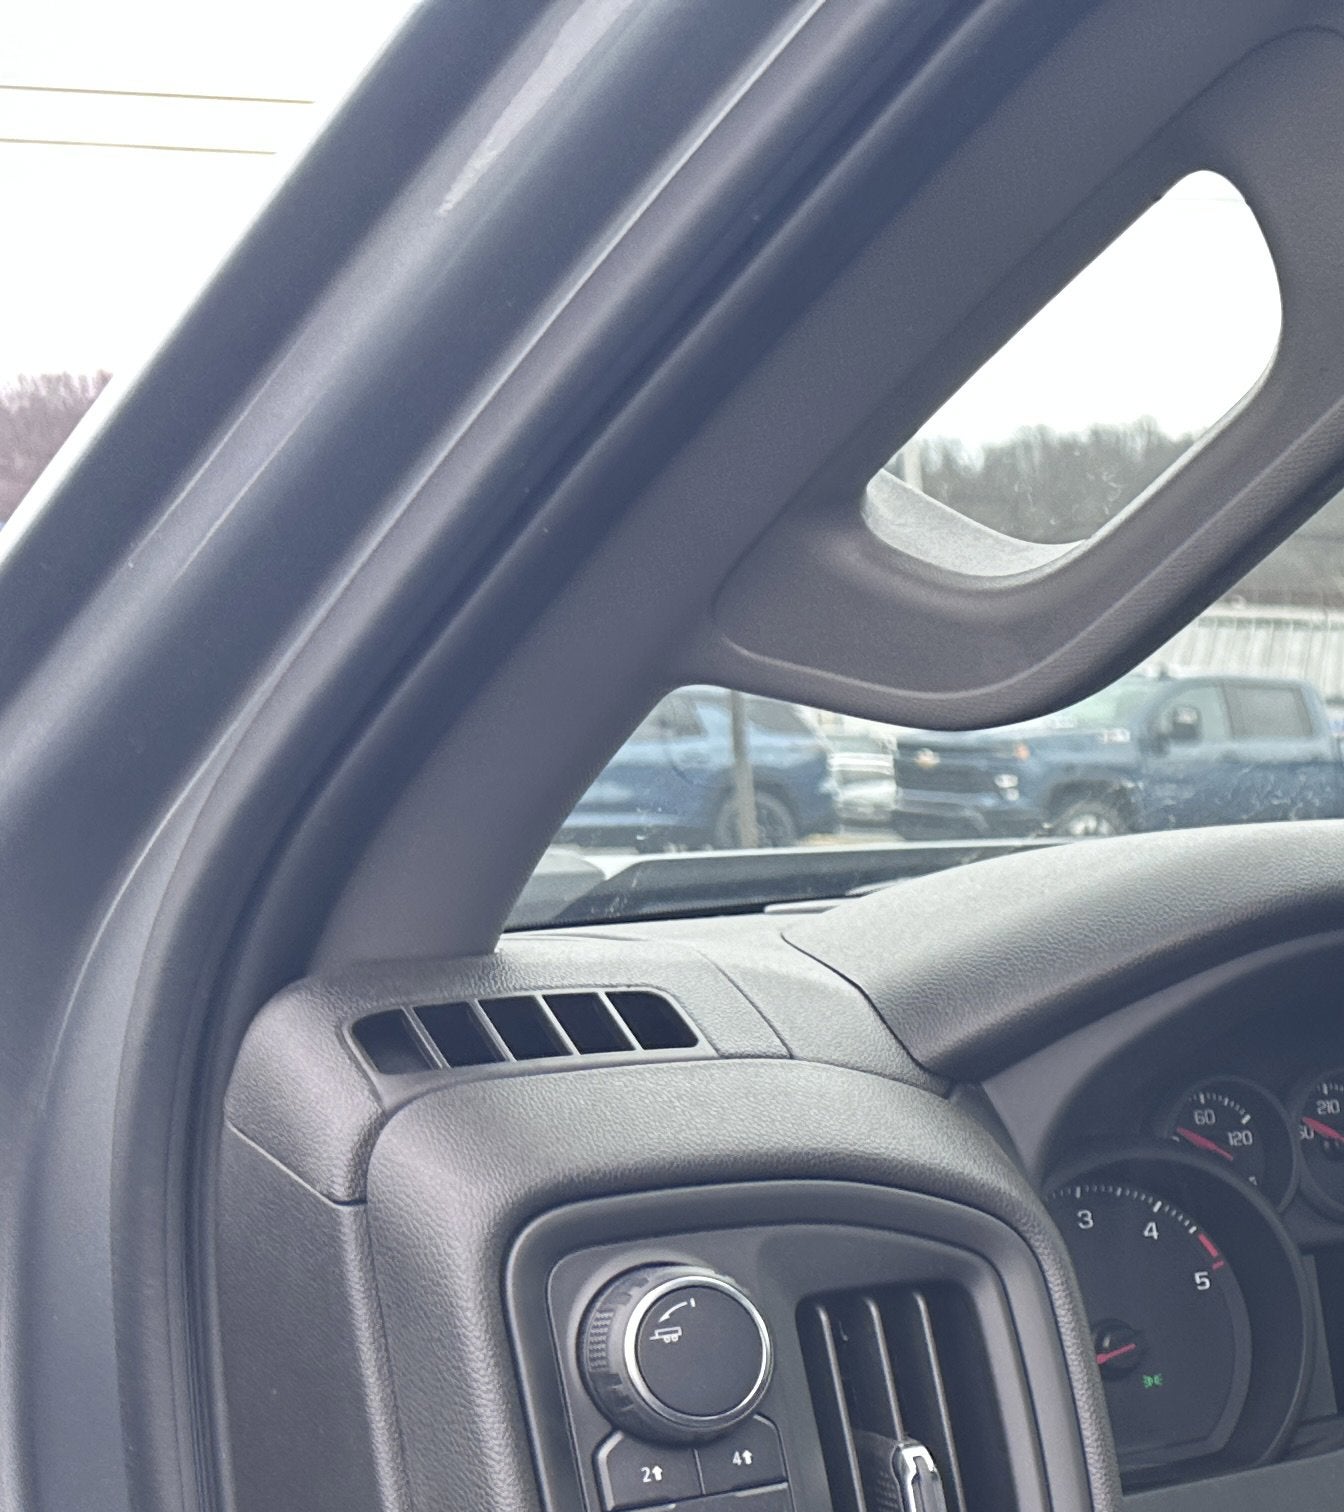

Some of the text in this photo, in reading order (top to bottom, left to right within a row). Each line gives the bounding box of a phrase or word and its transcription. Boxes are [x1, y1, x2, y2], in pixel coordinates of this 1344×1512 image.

[1316, 1098, 1341, 1116] 210
[1193, 1108, 1216, 1126] 60
[1227, 1129, 1253, 1147] 120
[1076, 1209, 1095, 1230] 3
[1142, 1221, 1160, 1241] 4
[1193, 1270, 1211, 1291] 5
